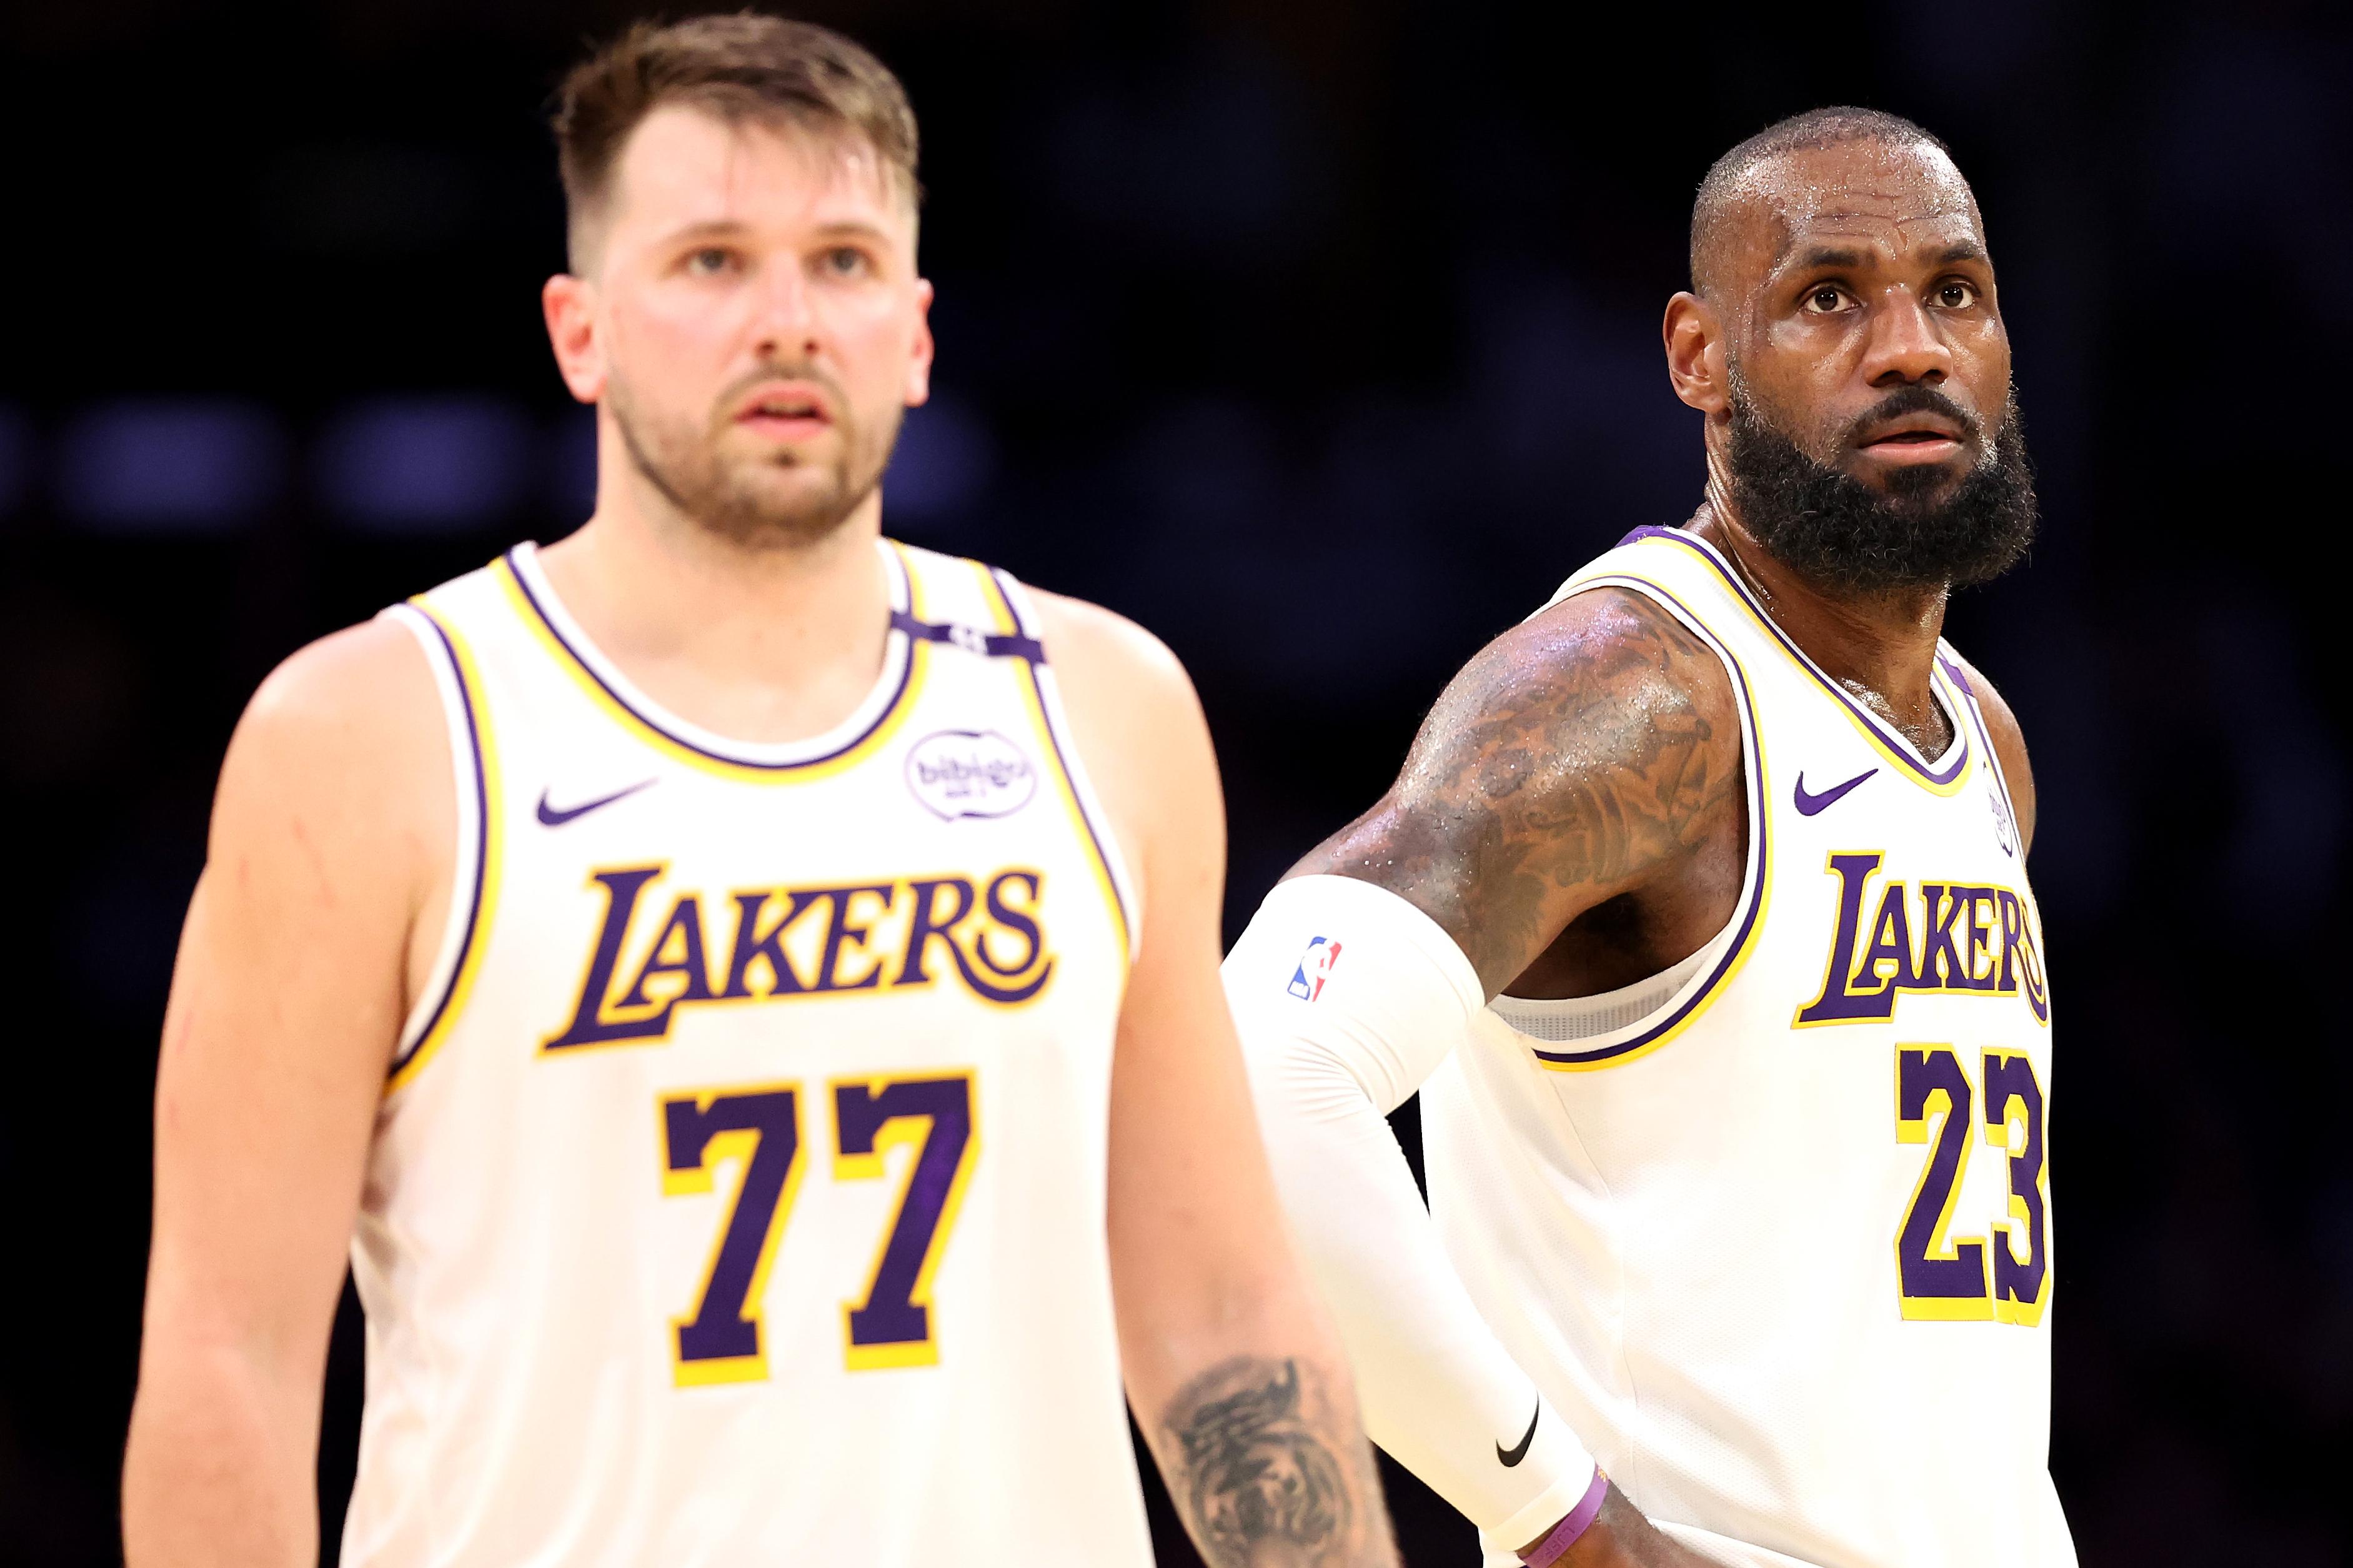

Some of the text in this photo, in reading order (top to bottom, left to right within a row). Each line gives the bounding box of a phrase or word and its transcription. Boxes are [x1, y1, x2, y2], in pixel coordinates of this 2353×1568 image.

[534, 860, 1058, 1061] LAKERS
[658, 1069, 982, 1388] 77
[1894, 1042, 2051, 1327] 23
